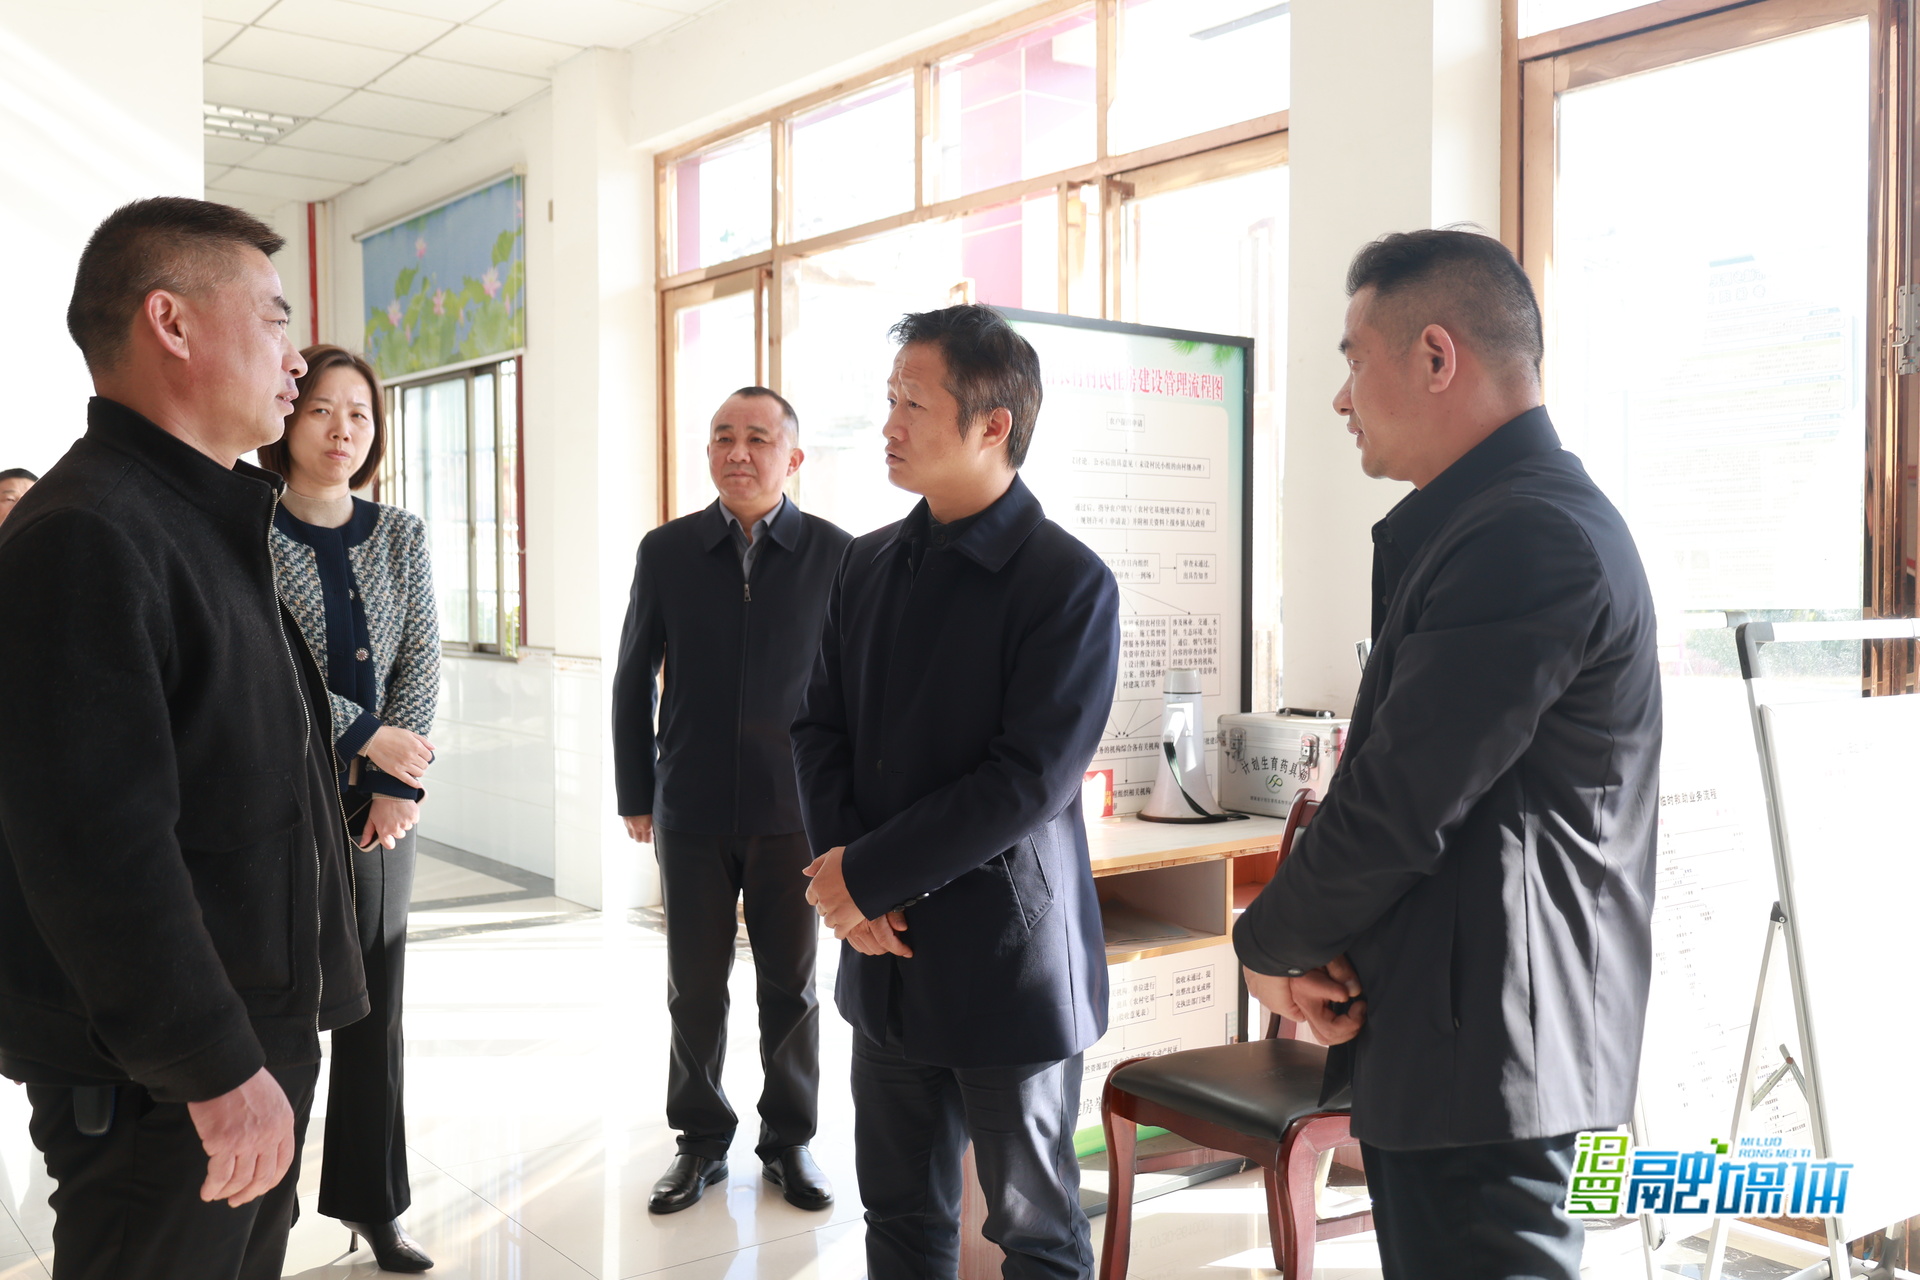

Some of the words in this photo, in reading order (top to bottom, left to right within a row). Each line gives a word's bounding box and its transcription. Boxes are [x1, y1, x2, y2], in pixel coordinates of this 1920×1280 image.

[1096, 741, 1160, 755] 务的机构综合各有关机构
